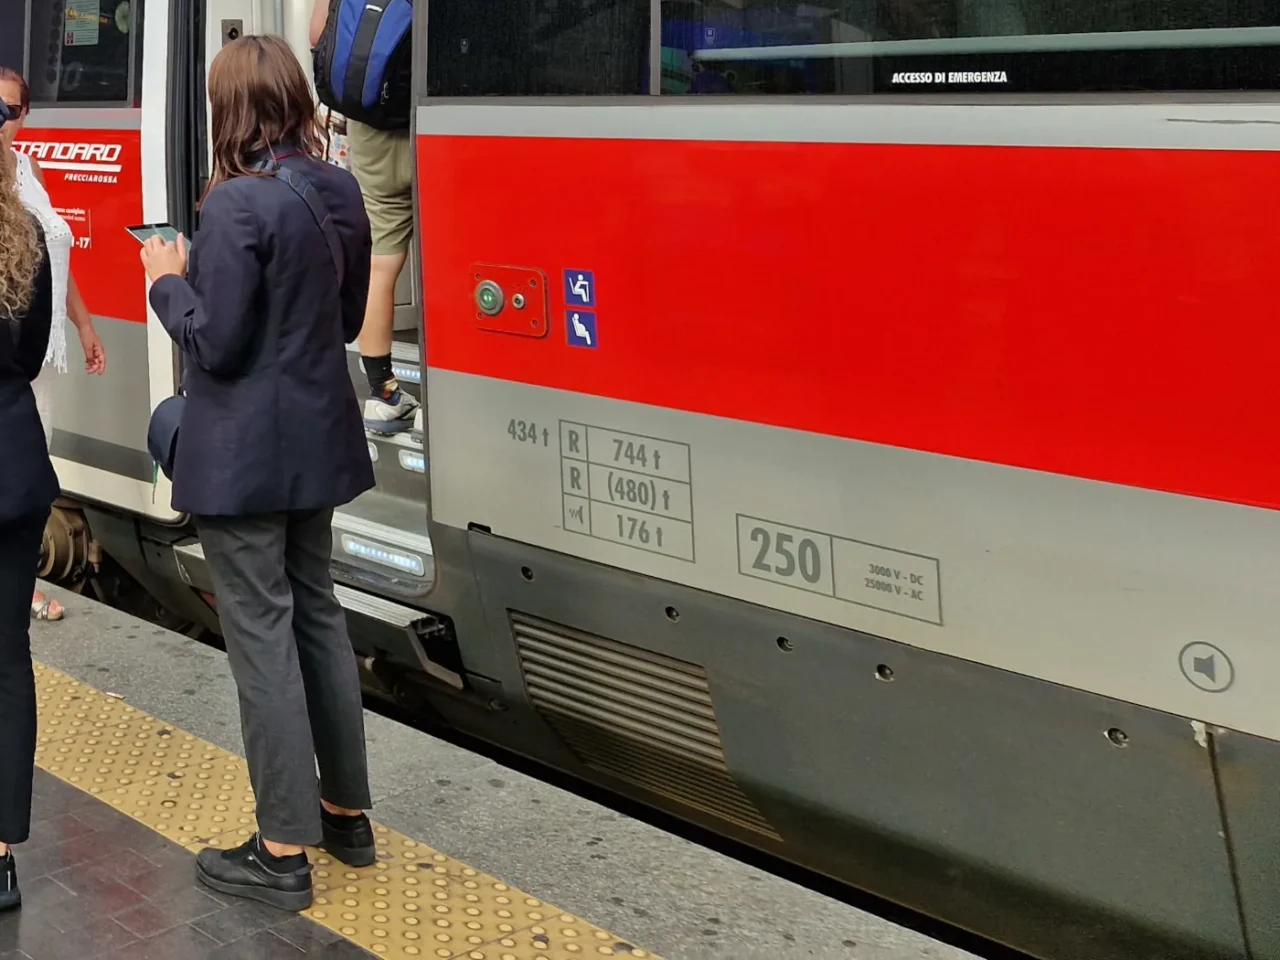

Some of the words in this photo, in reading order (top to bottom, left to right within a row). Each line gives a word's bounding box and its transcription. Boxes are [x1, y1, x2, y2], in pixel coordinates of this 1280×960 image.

[892, 72, 933, 84] ACCESSO
[934, 71, 946, 84] DI
[948, 71, 1008, 83] EMERGENZA
[64, 173, 118, 184] FRECCIAROSSA
[507, 418, 538, 445] 434
[542, 427, 549, 447] t
[568, 429, 580, 454] R
[612, 438, 648, 468] 744
[653, 449, 661, 470] t
[569, 466, 582, 490] R
[607, 470, 656, 511] (480)
[662, 489, 670, 510] t
[616, 514, 650, 545] 176
[656, 526, 663, 548] t
[750, 527, 821, 584] 250
[864, 577, 893, 593] 25000
[894, 584, 902, 595] V
[910, 588, 924, 601] AC
[868, 563, 892, 578] 3000
[893, 569, 901, 580] V
[909, 573, 924, 586] DC
